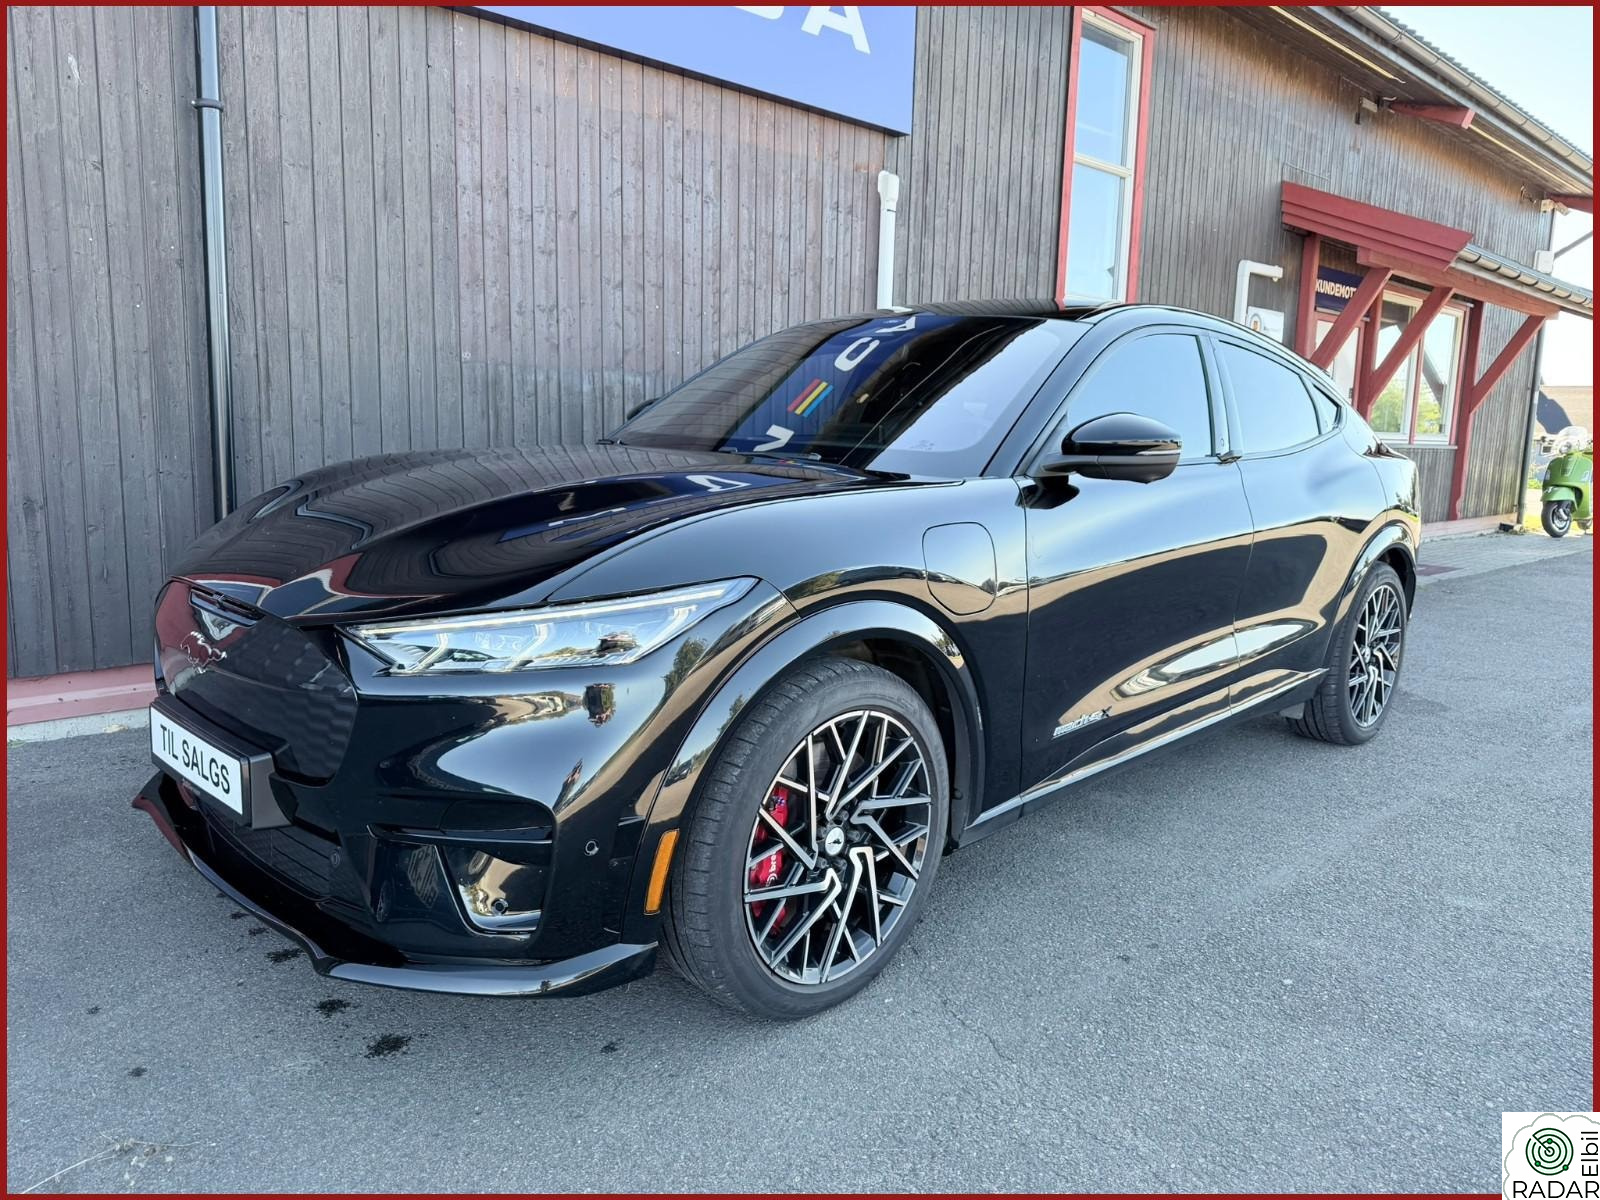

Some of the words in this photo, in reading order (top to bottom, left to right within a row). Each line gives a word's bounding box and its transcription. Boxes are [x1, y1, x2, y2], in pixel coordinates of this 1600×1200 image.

[1315, 280, 1357, 299] KUNDEMOT
[160, 724, 178, 760] TIL
[182, 739, 230, 794] SALGS
